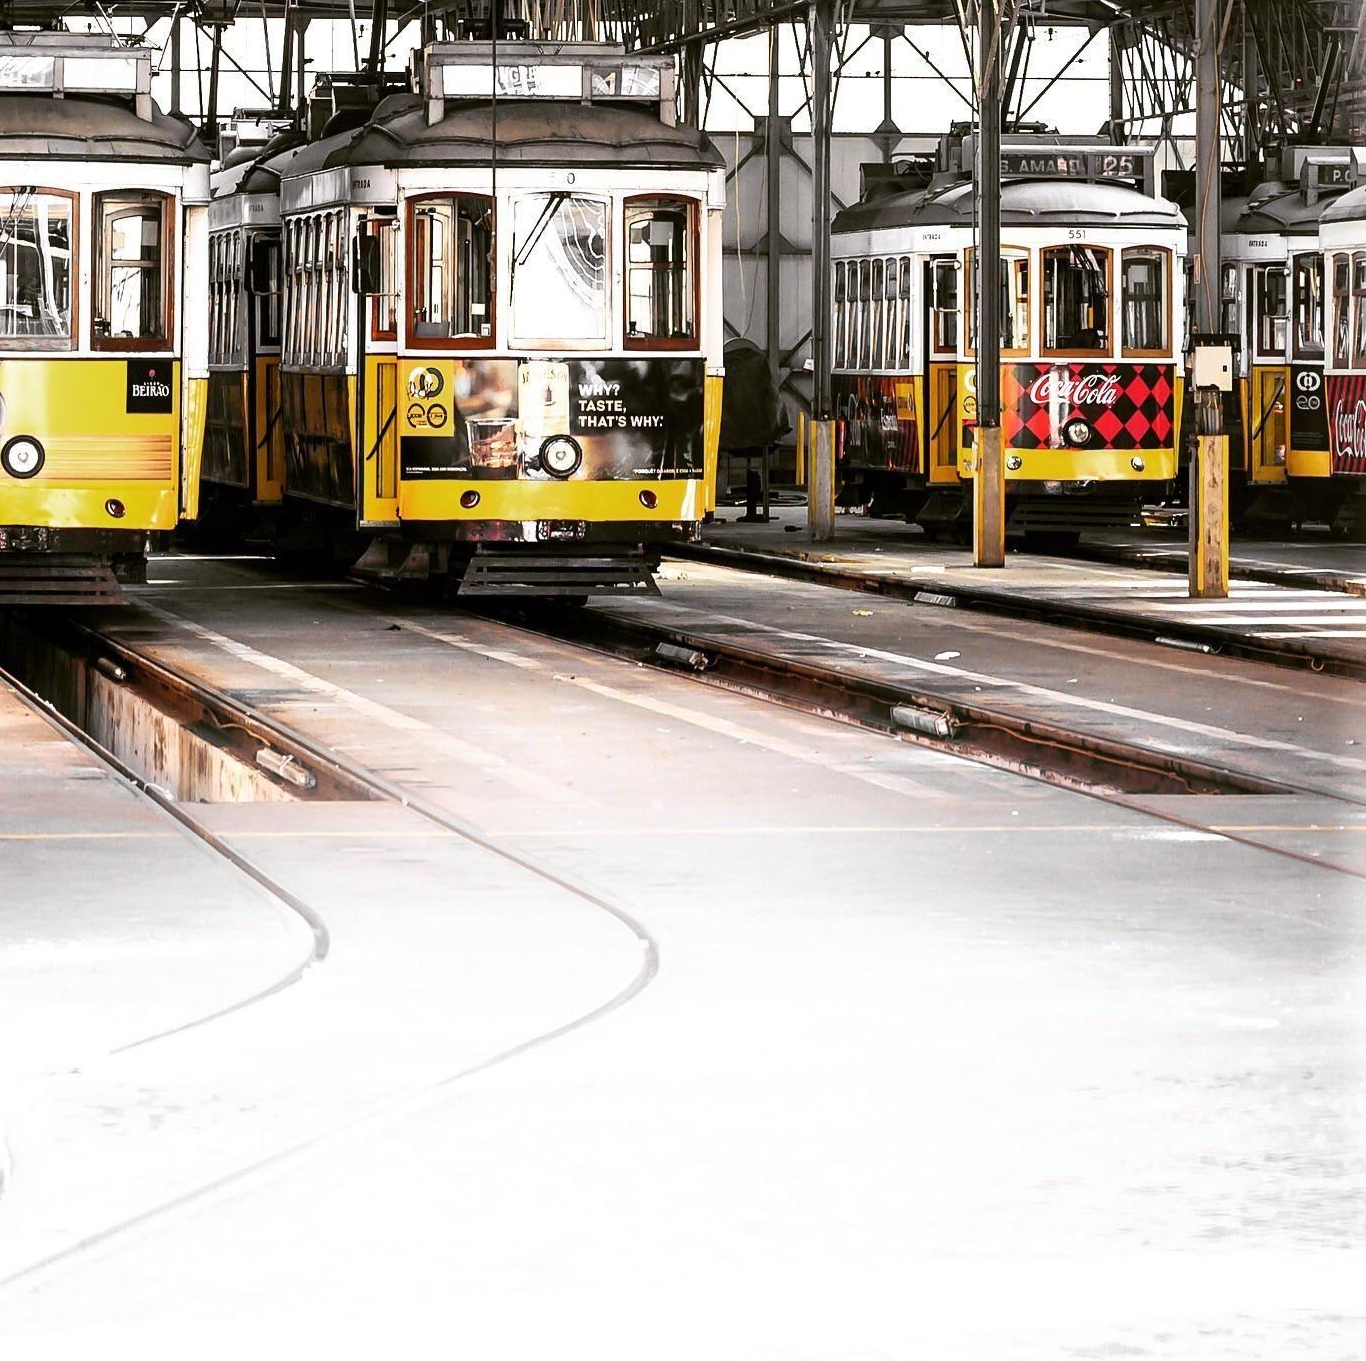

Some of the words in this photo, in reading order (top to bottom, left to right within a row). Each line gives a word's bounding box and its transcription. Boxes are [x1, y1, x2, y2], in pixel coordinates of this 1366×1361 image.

[1102, 156, 1133, 176] 25
[1068, 230, 1086, 239] 551
[132, 383, 170, 397] BEIRÃO
[578, 384, 621, 396] WHY?
[1030, 374, 1122, 405] Coca-Cola
[578, 400, 627, 413] TASTE,
[578, 416, 627, 427] THAT'S
